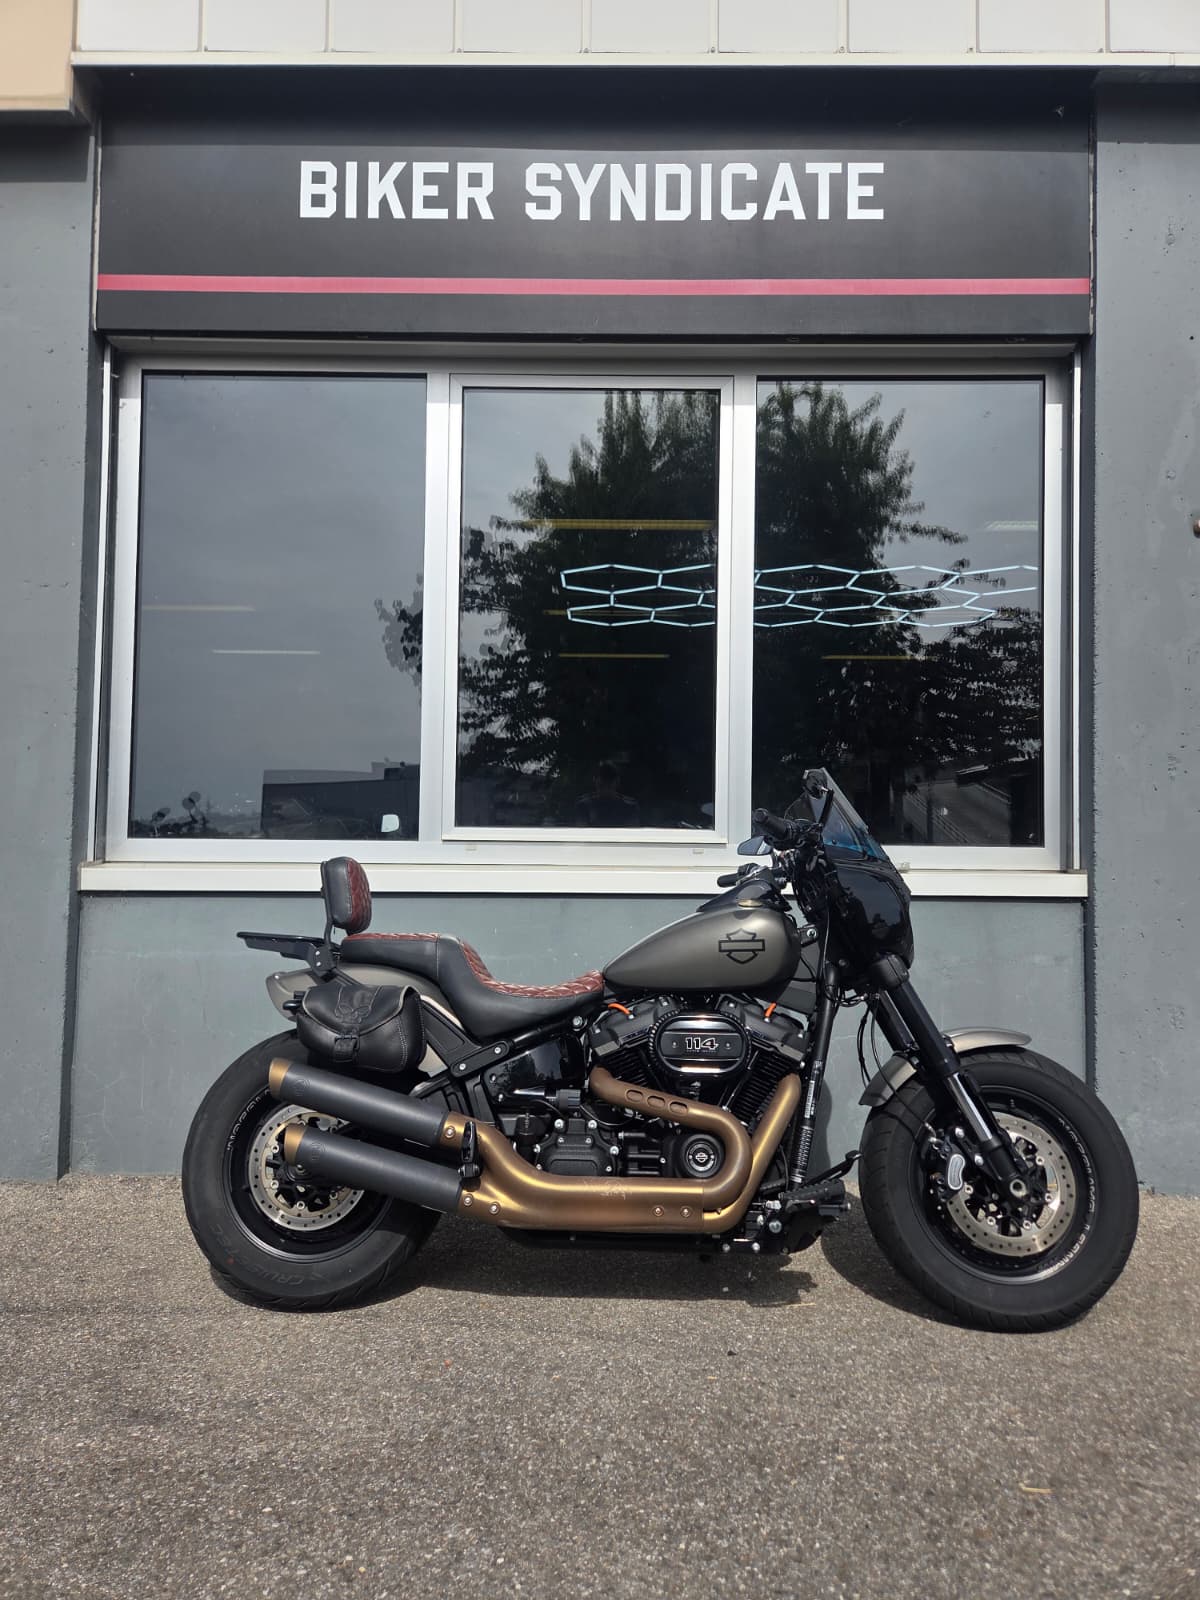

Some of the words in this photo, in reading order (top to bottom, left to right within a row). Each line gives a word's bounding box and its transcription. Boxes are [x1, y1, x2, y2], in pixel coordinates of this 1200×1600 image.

[300, 160, 494, 220] BIKER
[525, 161, 885, 221] SYNDICATE
[685, 1036, 719, 1050] 114
